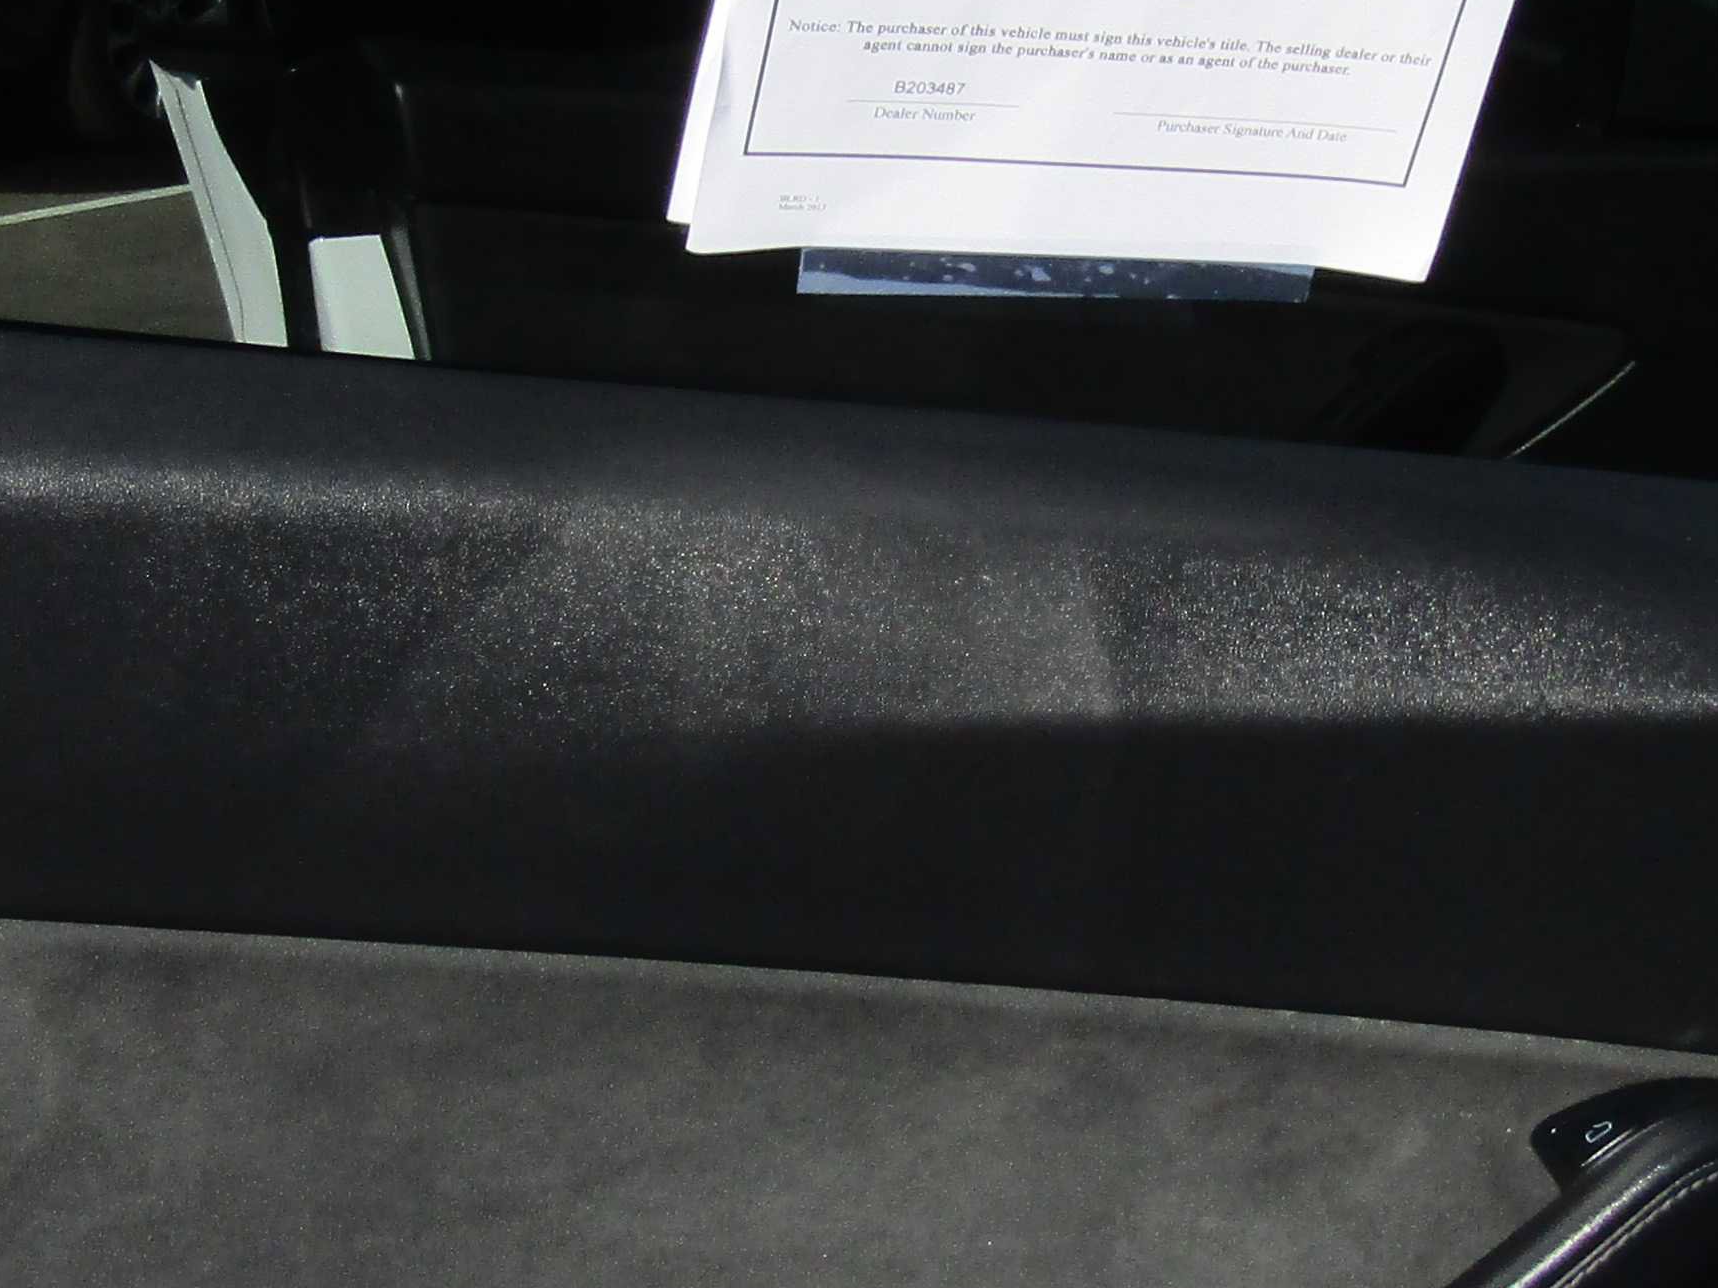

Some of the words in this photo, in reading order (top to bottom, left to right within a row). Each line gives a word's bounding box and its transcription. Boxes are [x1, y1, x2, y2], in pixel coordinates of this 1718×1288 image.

[788, 18, 841, 32] Notice:
[846, 19, 874, 34] The
[876, 21, 948, 37] purchaser
[949, 22, 969, 37] of
[969, 23, 996, 37] this
[1000, 25, 1052, 40] vehicle
[1053, 30, 1090, 42] must
[1092, 30, 1123, 47] sign
[1126, 32, 1153, 46] this
[1156, 34, 1216, 50] vehicle's
[1219, 38, 1250, 52] title.
[1257, 39, 1282, 54] The
[1284, 42, 1332, 60] selling
[1334, 45, 1378, 60] dealer
[1379, 53, 1396, 63] or
[1398, 52, 1432, 66] their
[862, 39, 903, 54] agent
[905, 41, 953, 53] cannot
[956, 40, 987, 56] sign
[990, 42, 1013, 55] the
[1015, 44, 1095, 59] purchaser's
[1098, 50, 1137, 62] name
[1139, 53, 1156, 63] or
[1158, 54, 1174, 64] as
[1176, 55, 1195, 65] an
[1196, 56, 1236, 70] agent
[1238, 56, 1257, 68] of
[1256, 56, 1279, 70] the
[1280, 60, 1349, 75] purchaser.
[893, 79, 966, 96] B203487
[873, 105, 919, 120] Dealer
[921, 107, 976, 121] Number
[1156, 119, 1221, 134] Purchaser
[1221, 122, 1284, 138] Signature
[1284, 126, 1315, 140] And
[1315, 128, 1348, 142] Date
